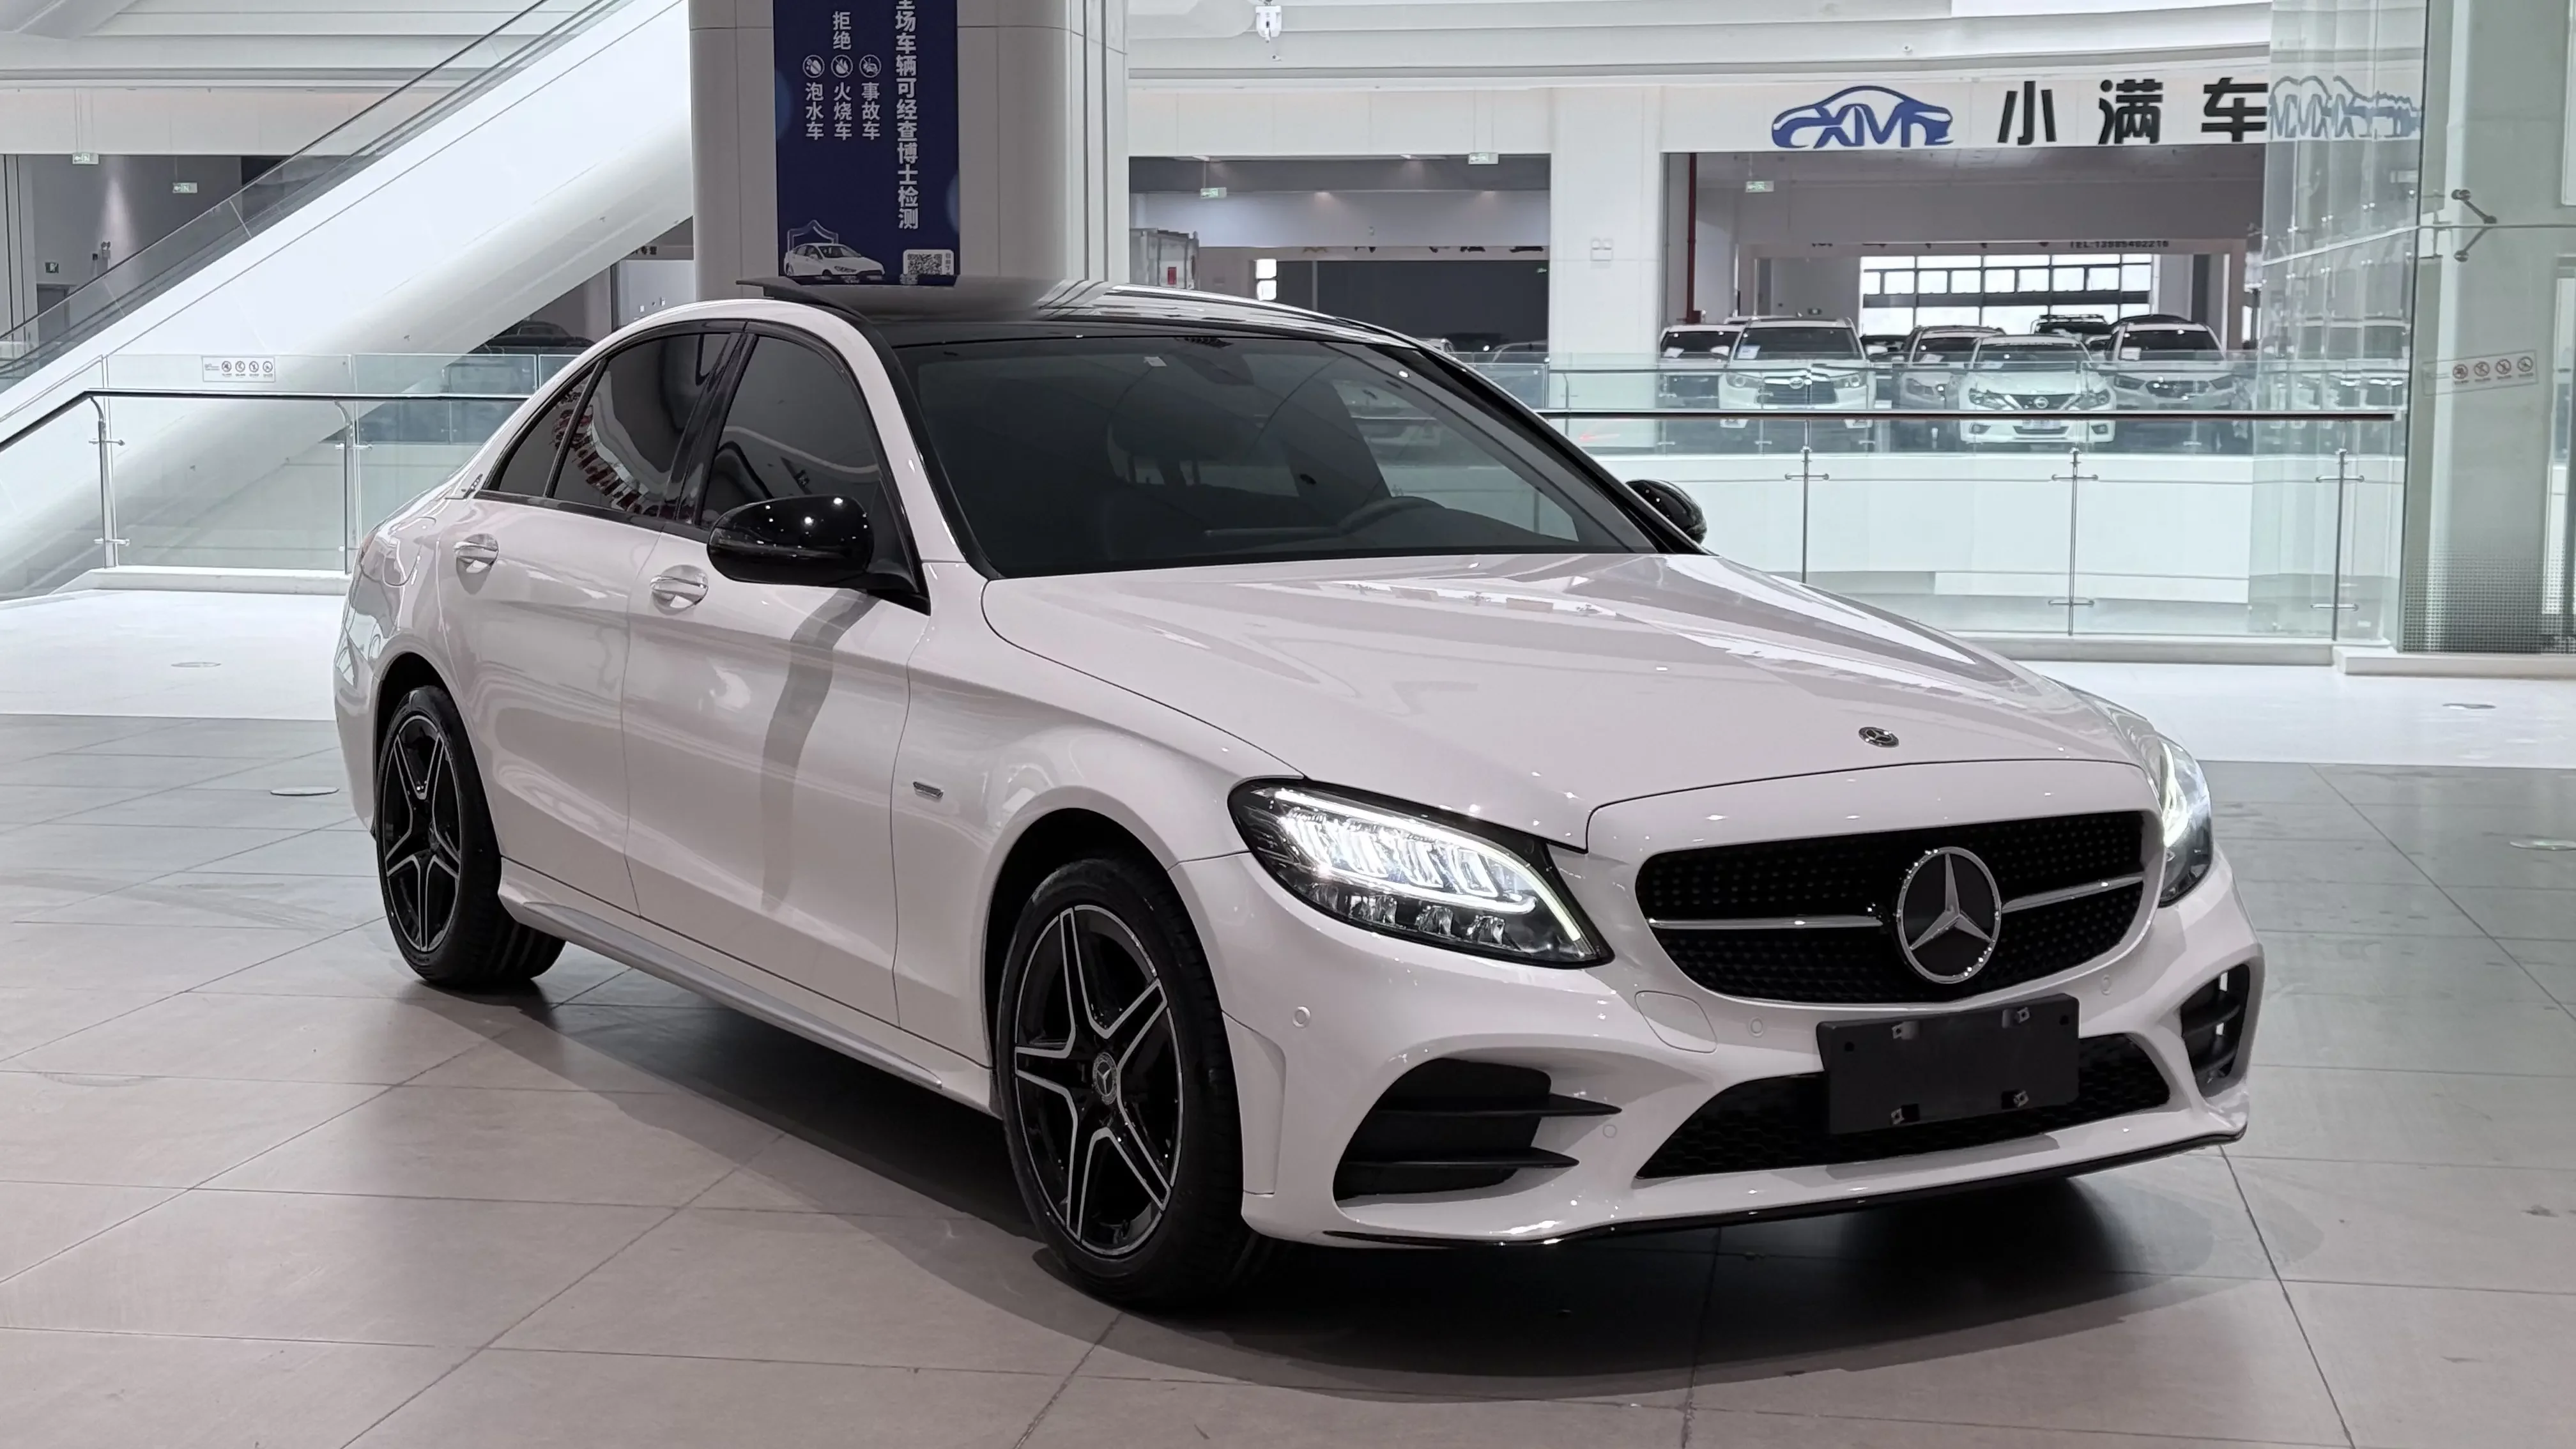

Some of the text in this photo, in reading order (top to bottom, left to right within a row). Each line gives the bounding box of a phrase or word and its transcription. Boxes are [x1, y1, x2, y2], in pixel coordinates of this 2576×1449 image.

[832, 11, 852, 50] 拒绝
[805, 82, 824, 140] 泡水车
[833, 82, 852, 141] 火烧车
[861, 82, 880, 141] 事故车
[1998, 77, 2267, 145] 小满车
